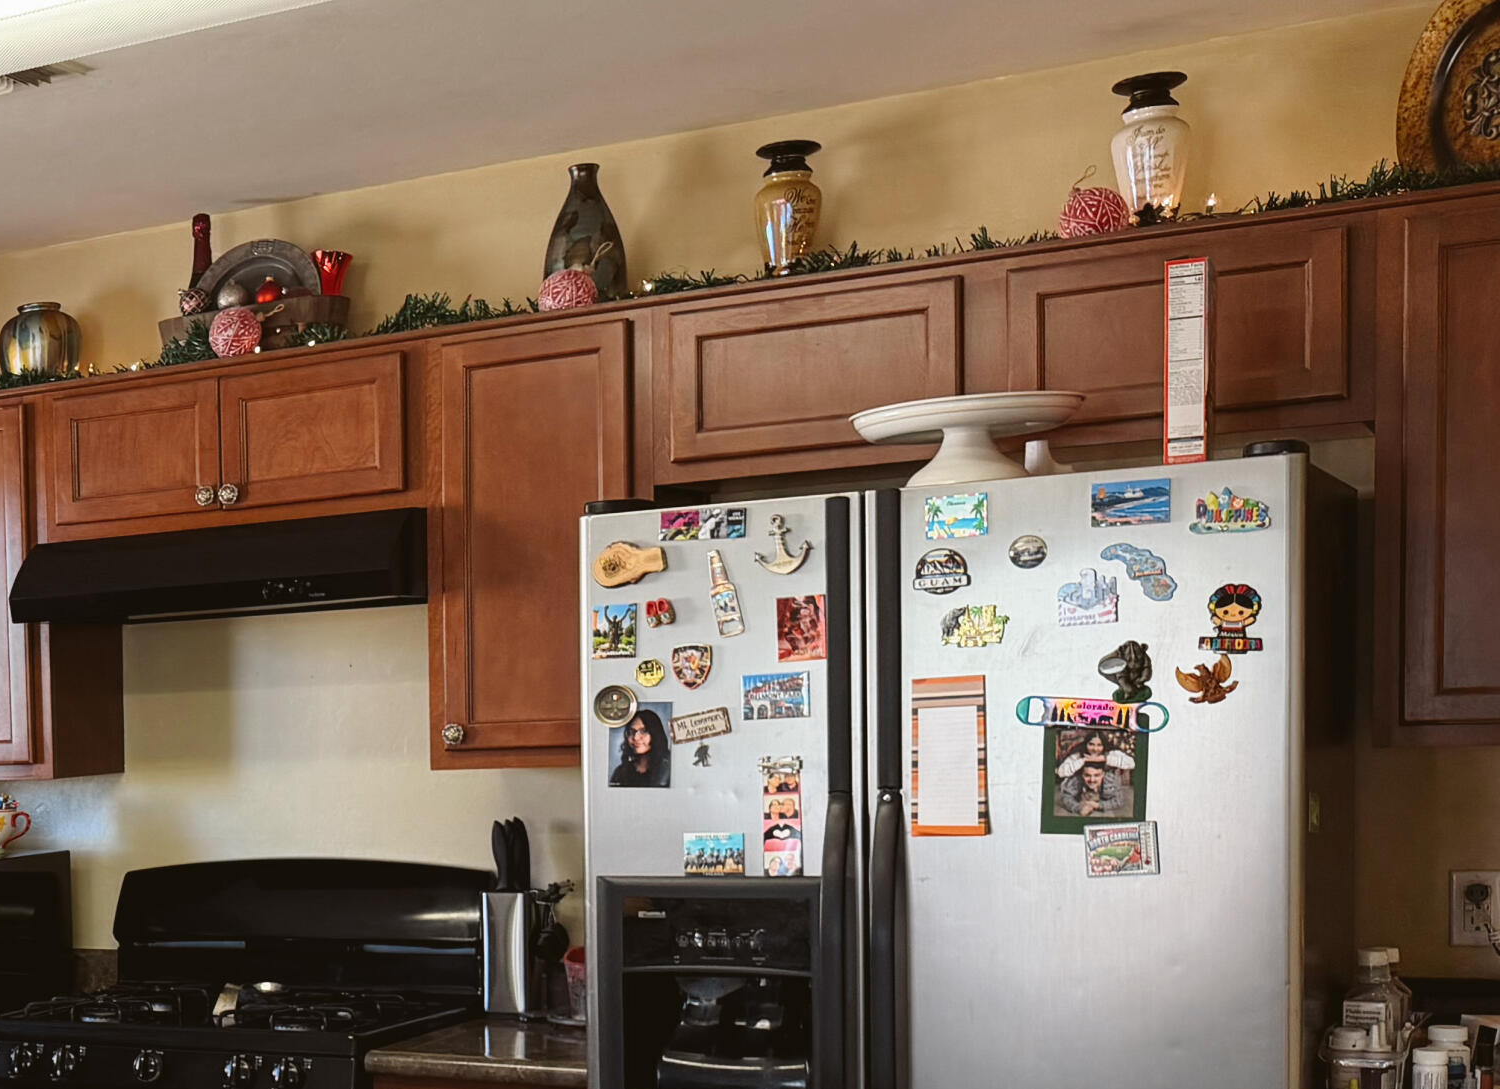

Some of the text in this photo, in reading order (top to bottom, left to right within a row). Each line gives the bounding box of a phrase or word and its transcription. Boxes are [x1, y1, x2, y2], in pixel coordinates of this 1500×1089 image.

[918, 577, 963, 587] GUAM
[1070, 701, 1115, 711] Colorado
[686, 723, 717, 738] Arizona
